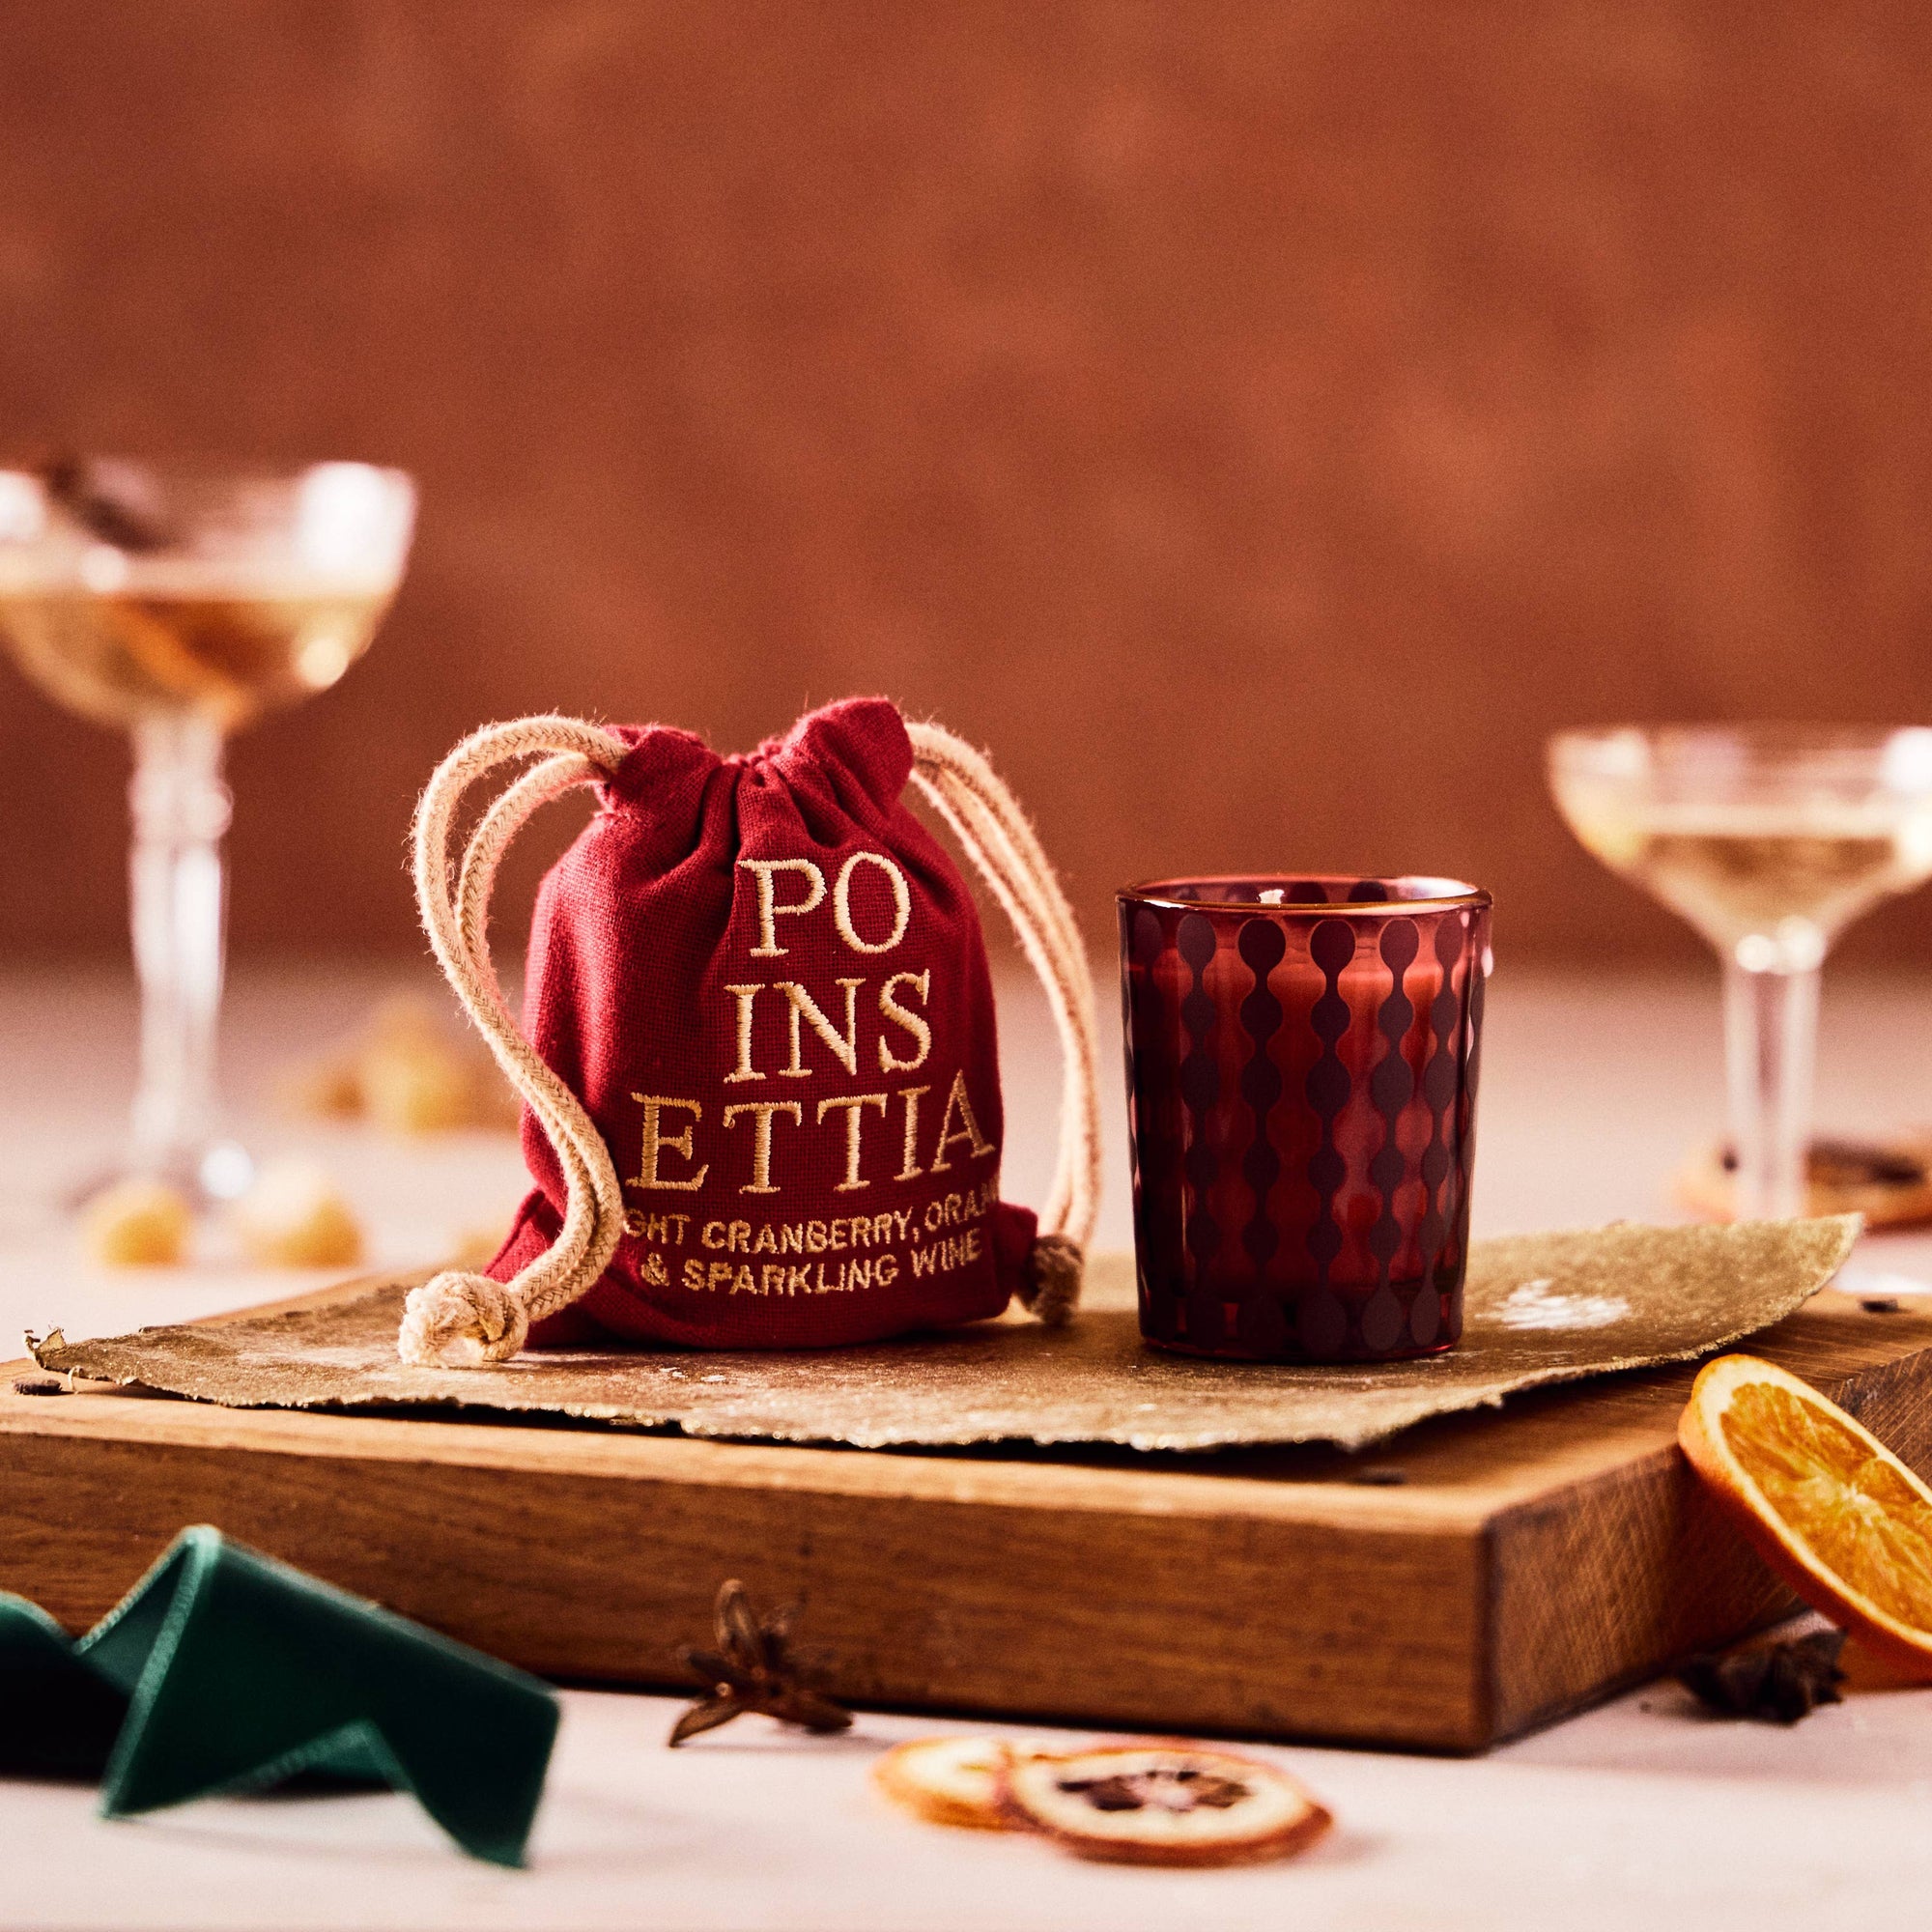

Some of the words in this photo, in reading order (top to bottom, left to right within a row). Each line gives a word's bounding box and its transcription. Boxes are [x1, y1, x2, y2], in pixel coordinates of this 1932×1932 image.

[737, 851, 911, 957] PO
[724, 969, 932, 1083] INS
[626, 1069, 996, 1194] ETTIA
[641, 1252, 670, 1287] &
[682, 1254, 899, 1296] SPARKLING
[910, 1227, 982, 1278] WINE
[701, 1206, 920, 1254] CRANBERRY,
